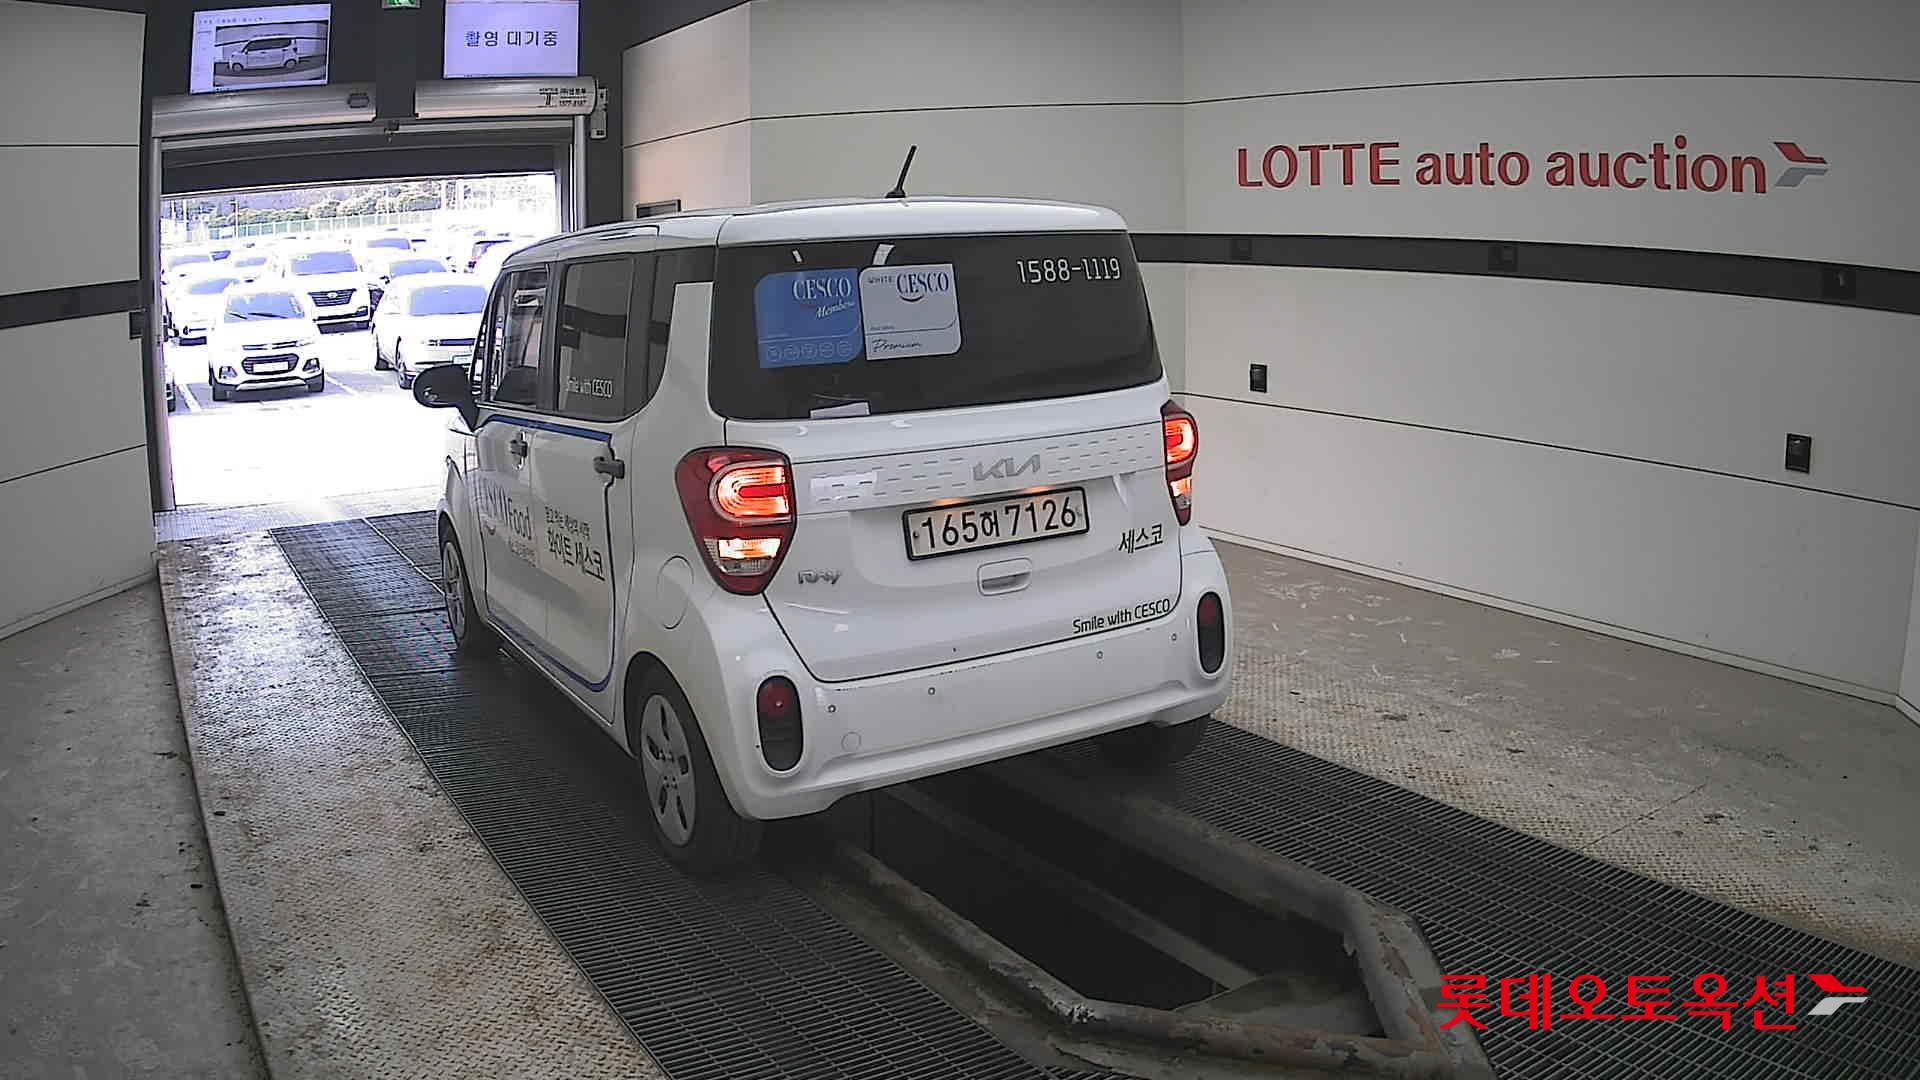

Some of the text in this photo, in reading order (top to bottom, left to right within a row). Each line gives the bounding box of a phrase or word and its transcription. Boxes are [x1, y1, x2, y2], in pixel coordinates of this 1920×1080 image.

[465, 31, 558, 47] 촬영 대기중
[1237, 135, 1767, 194] LOTTE auto auction
[897, 272, 949, 294] CESCO
[1017, 258, 1120, 283] 1588-1119
[792, 277, 852, 301] CESCO
[973, 454, 1041, 481] KIA
[507, 496, 533, 541] Food
[1118, 524, 1164, 554] 세스코
[575, 541, 606, 582] 세스코
[1073, 598, 1170, 634] Smile with CESCO
